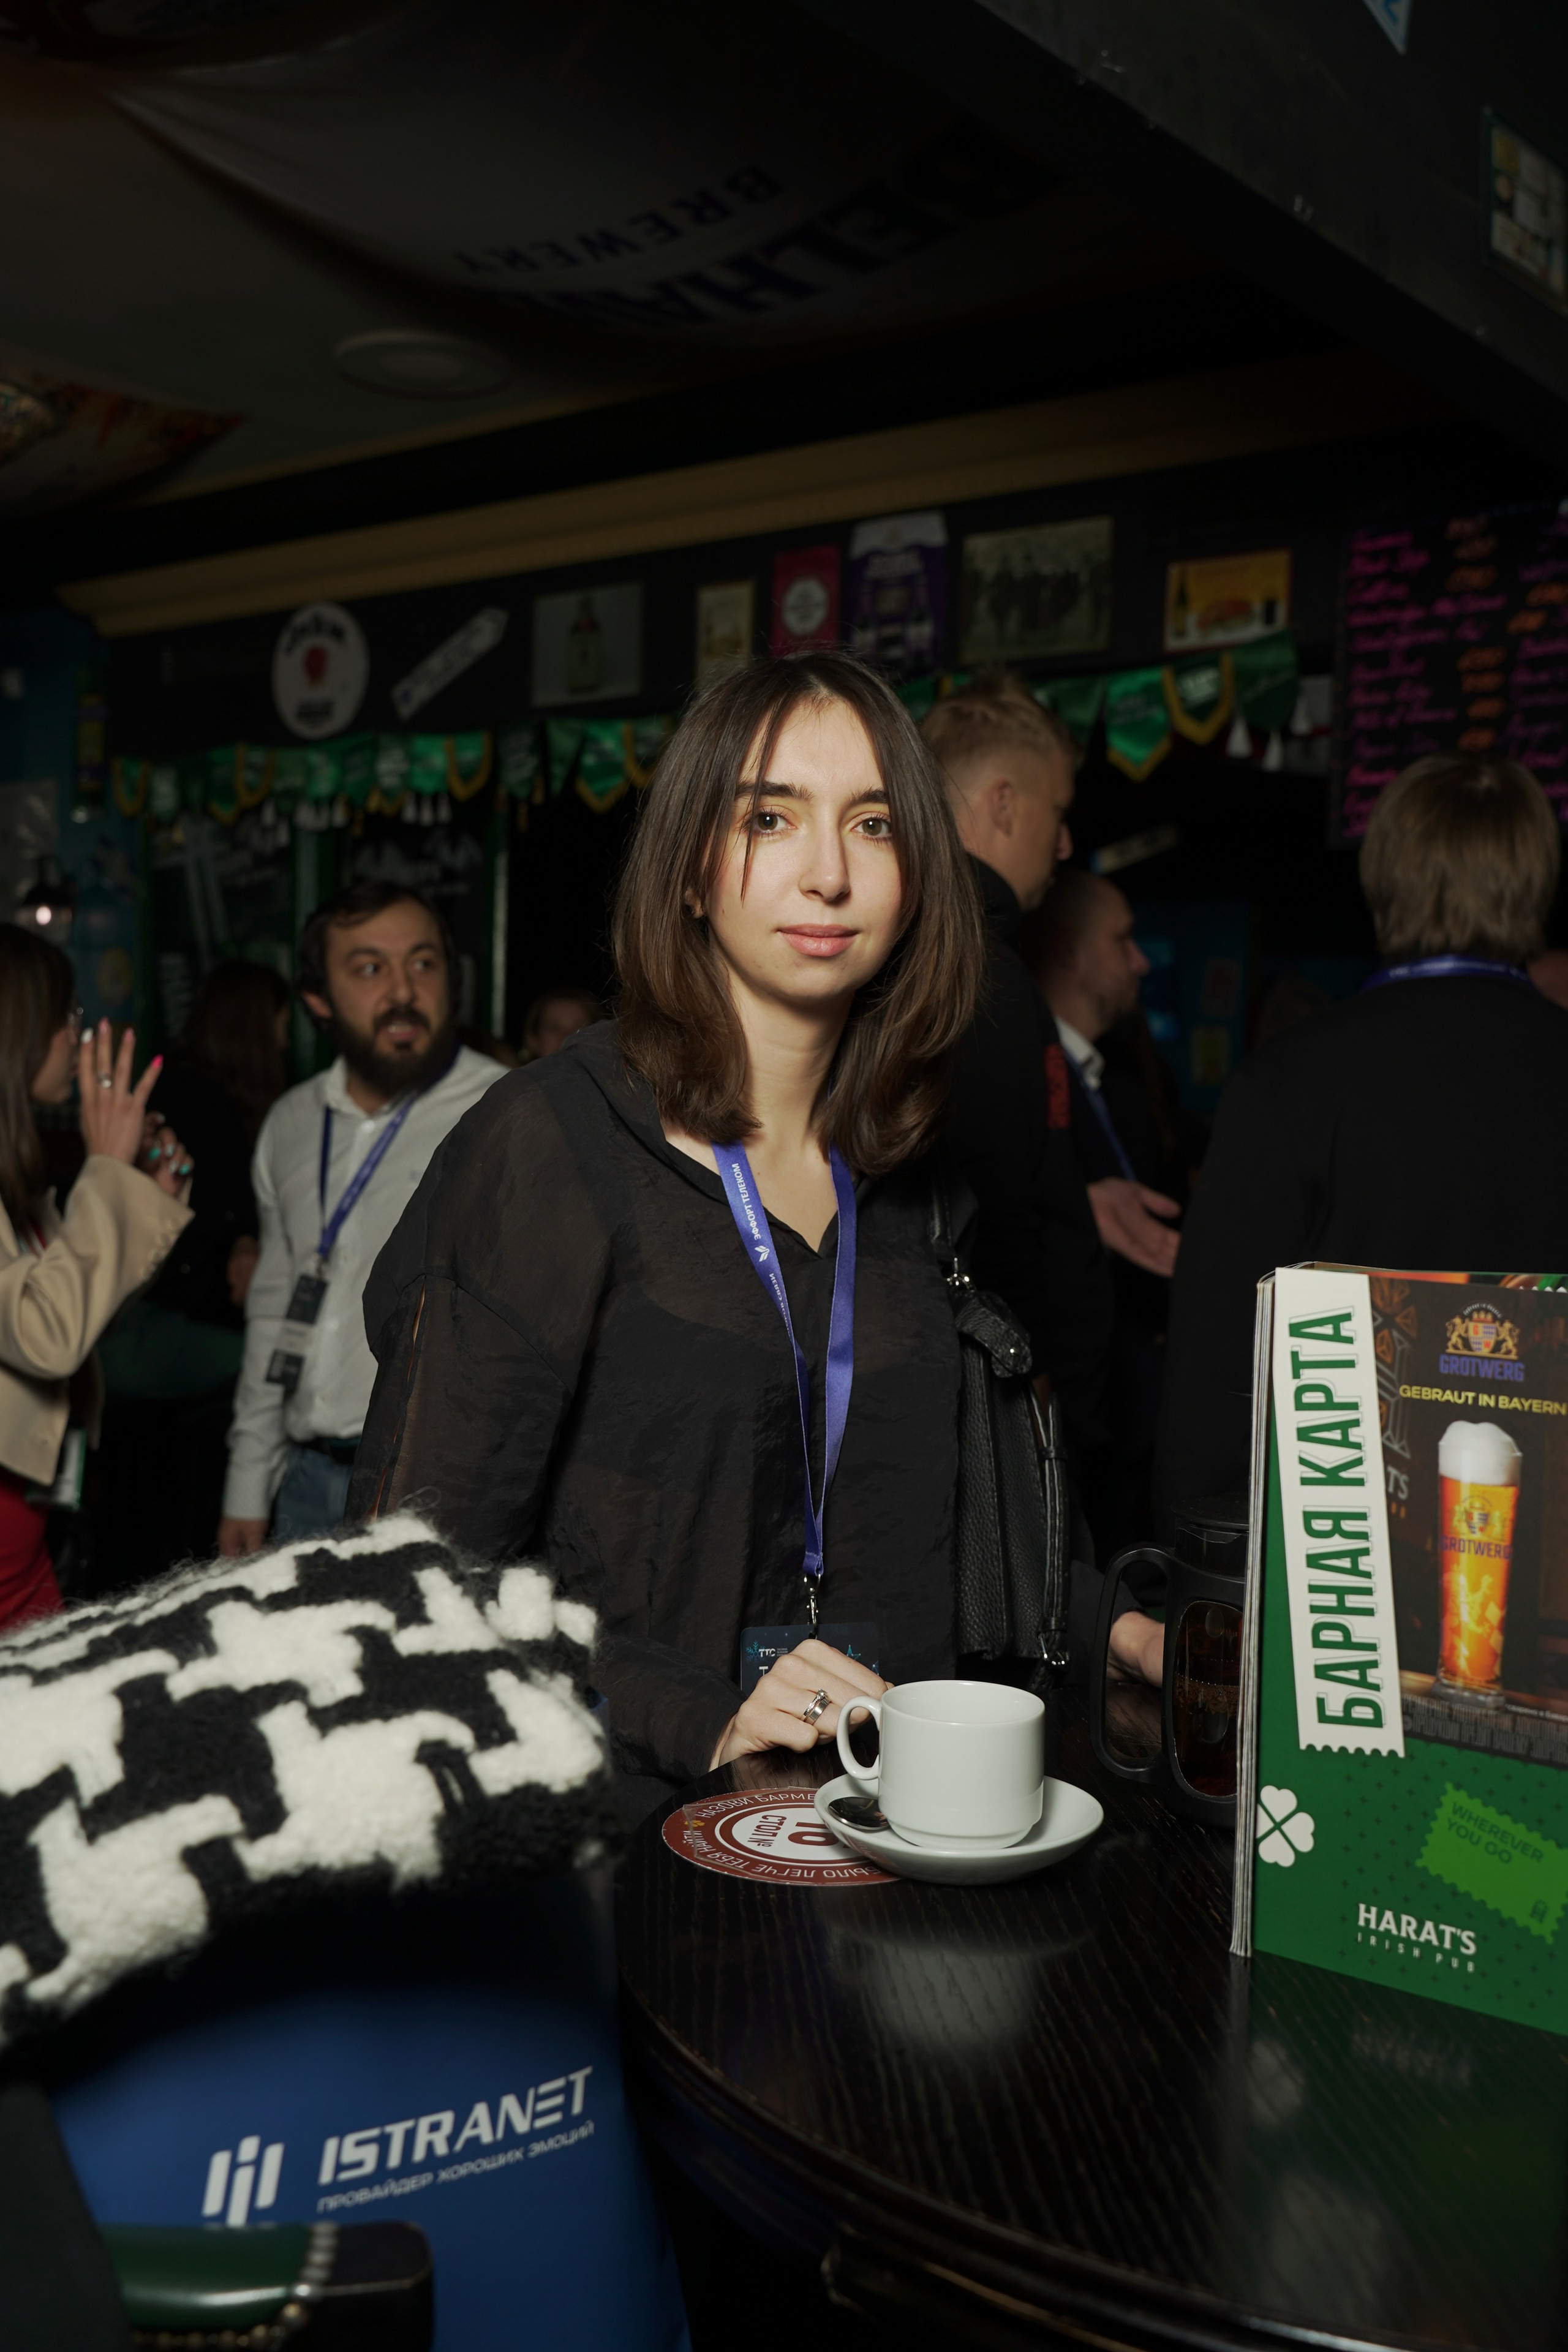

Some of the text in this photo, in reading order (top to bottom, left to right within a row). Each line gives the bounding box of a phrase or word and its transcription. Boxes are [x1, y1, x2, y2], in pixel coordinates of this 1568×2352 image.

[451, 165, 784, 277] BREWERY
[731, 1163, 761, 1240] ЭФФОРТ ТЕЛЕКОМ
[1439, 1353, 1524, 1382] GROTWERG
[1398, 1384, 1568, 1416] GEBRAUT IN BAYERN
[1288, 1311, 1383, 1729] БАРНАЯ КАРТА
[1439, 1534, 1513, 1559] GROTWERG
[682, 1792, 882, 1878] НАЗОВИ БАРМЕ БЫЛО ЛЕГЧЕ ТЕБЯ НАЙТИ
[755, 1814, 787, 1838] СТОЛ
[1447, 1817, 1513, 1864] YOU GO
[1452, 1801, 1544, 1864] WHEREVER
[1356, 1902, 1477, 1956] HARAT'S
[1357, 1931, 1476, 1973] IRISH PUB
[317, 2065, 594, 2187] ISTRANET
[315, 2119, 595, 2215] ПРОВАЙДЕР ХОРОШИХ ЭМОЦИЙ
